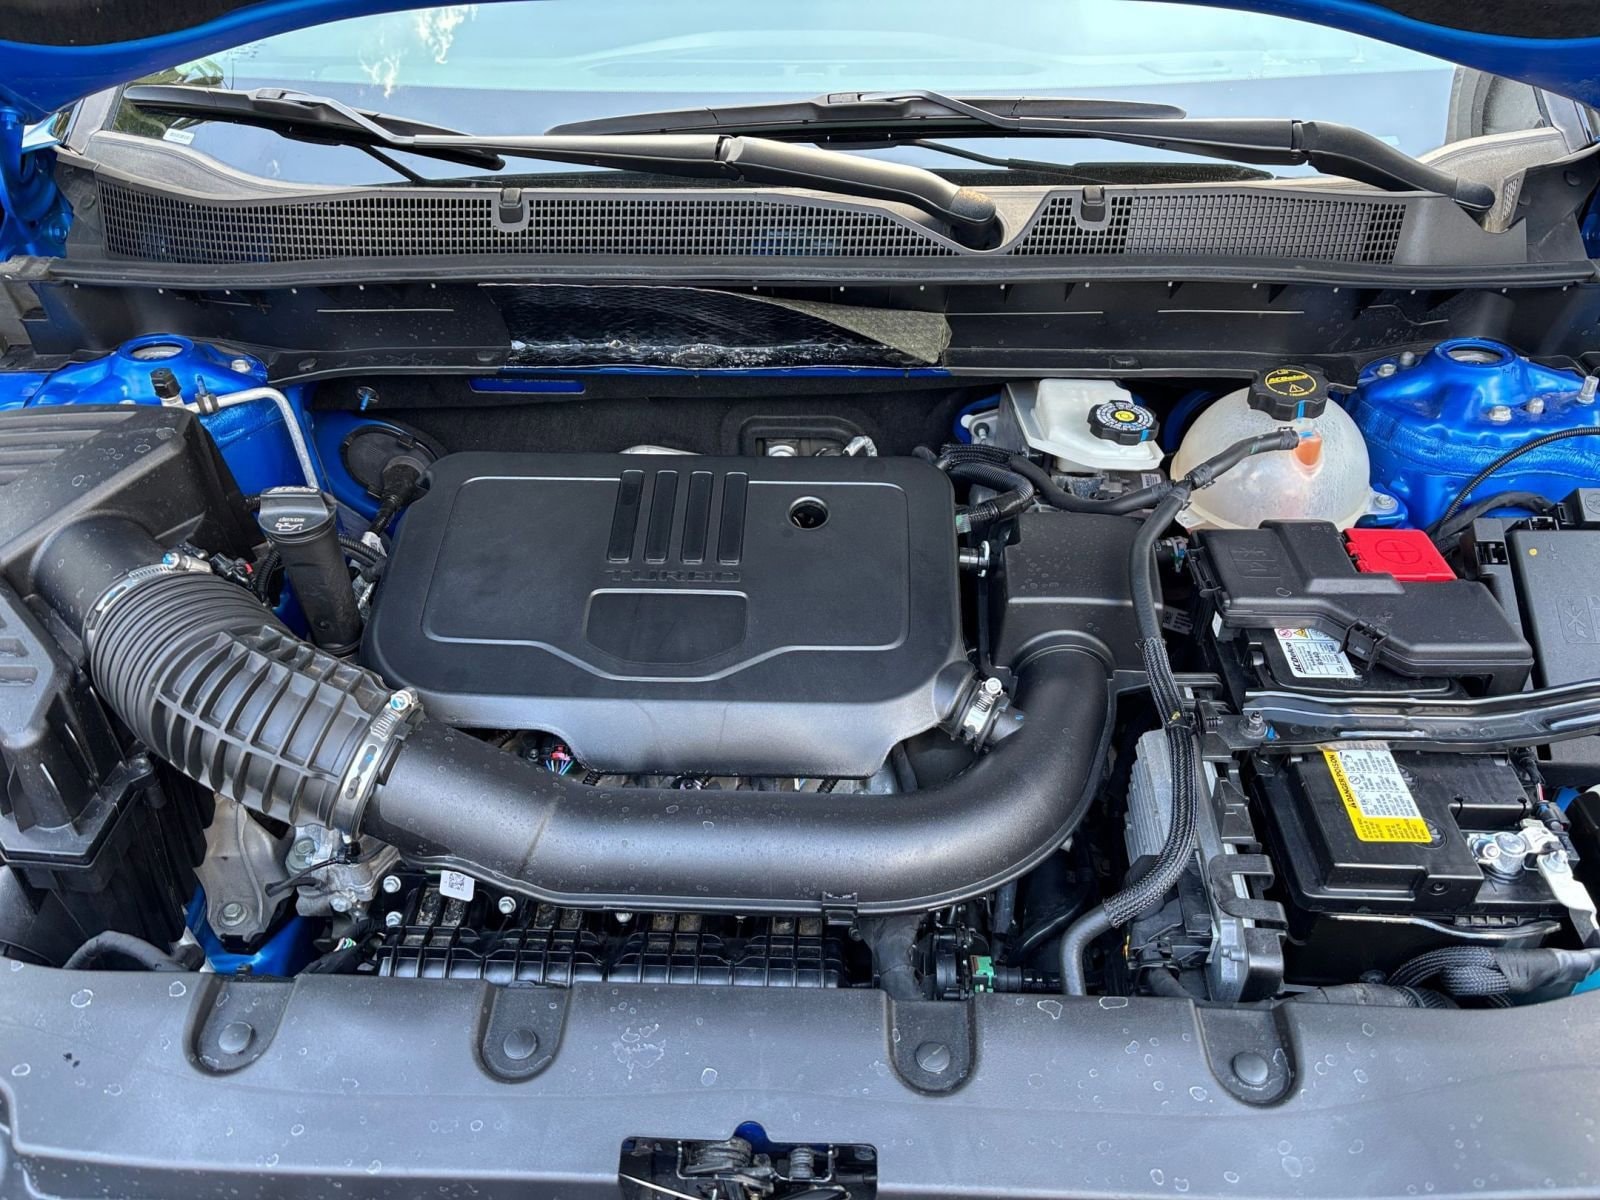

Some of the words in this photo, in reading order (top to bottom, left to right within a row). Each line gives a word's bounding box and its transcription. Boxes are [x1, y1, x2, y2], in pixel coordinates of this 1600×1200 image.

[1267, 373, 1308, 384] ACDelco
[267, 486, 318, 494] ACDelco
[605, 569, 741, 583] TURBO
[1285, 642, 1304, 673] ACDelco
[1329, 754, 1342, 776] POISON
[1339, 777, 1354, 803] DANGER
